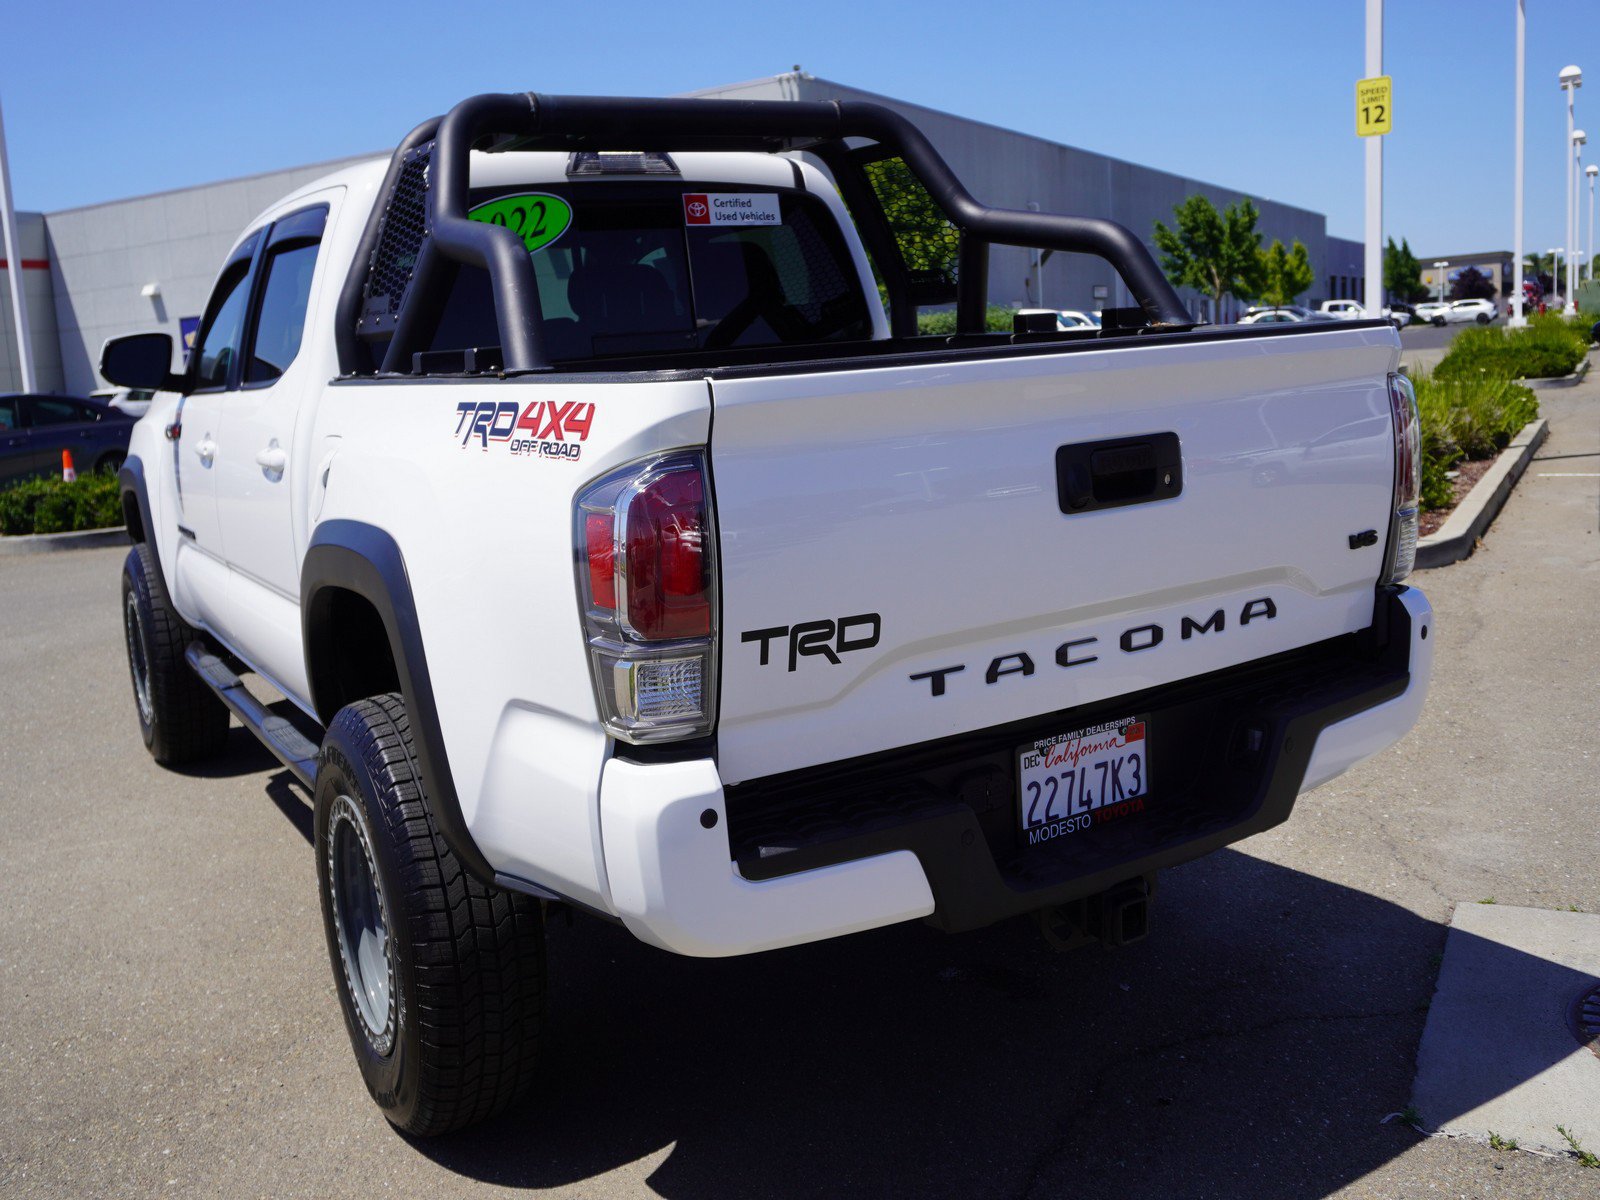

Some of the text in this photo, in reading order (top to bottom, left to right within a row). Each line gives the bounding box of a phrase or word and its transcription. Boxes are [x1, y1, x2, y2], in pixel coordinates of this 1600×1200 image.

[1360, 86, 1388, 95] SPEED
[1362, 95, 1385, 104] LIMIT
[1362, 105, 1385, 125] 12
[713, 198, 752, 208] Certified
[715, 211, 776, 221] Used Vehicles
[474, 201, 547, 240] 22
[454, 401, 520, 452] TRD
[510, 439, 582, 462] OFF ROAD
[741, 612, 882, 672] TRD
[909, 597, 1278, 697] TACOMA
[1033, 736, 1057, 750] PRICE
[1058, 729, 1085, 745] FAMILY
[1086, 716, 1136, 735] DEALERSHIPS
[1024, 753, 1041, 770] DEC
[1044, 733, 1126, 769] California
[1026, 753, 1141, 828] 22747K3
[1029, 799, 1145, 845] MODESTO TOYOTA
